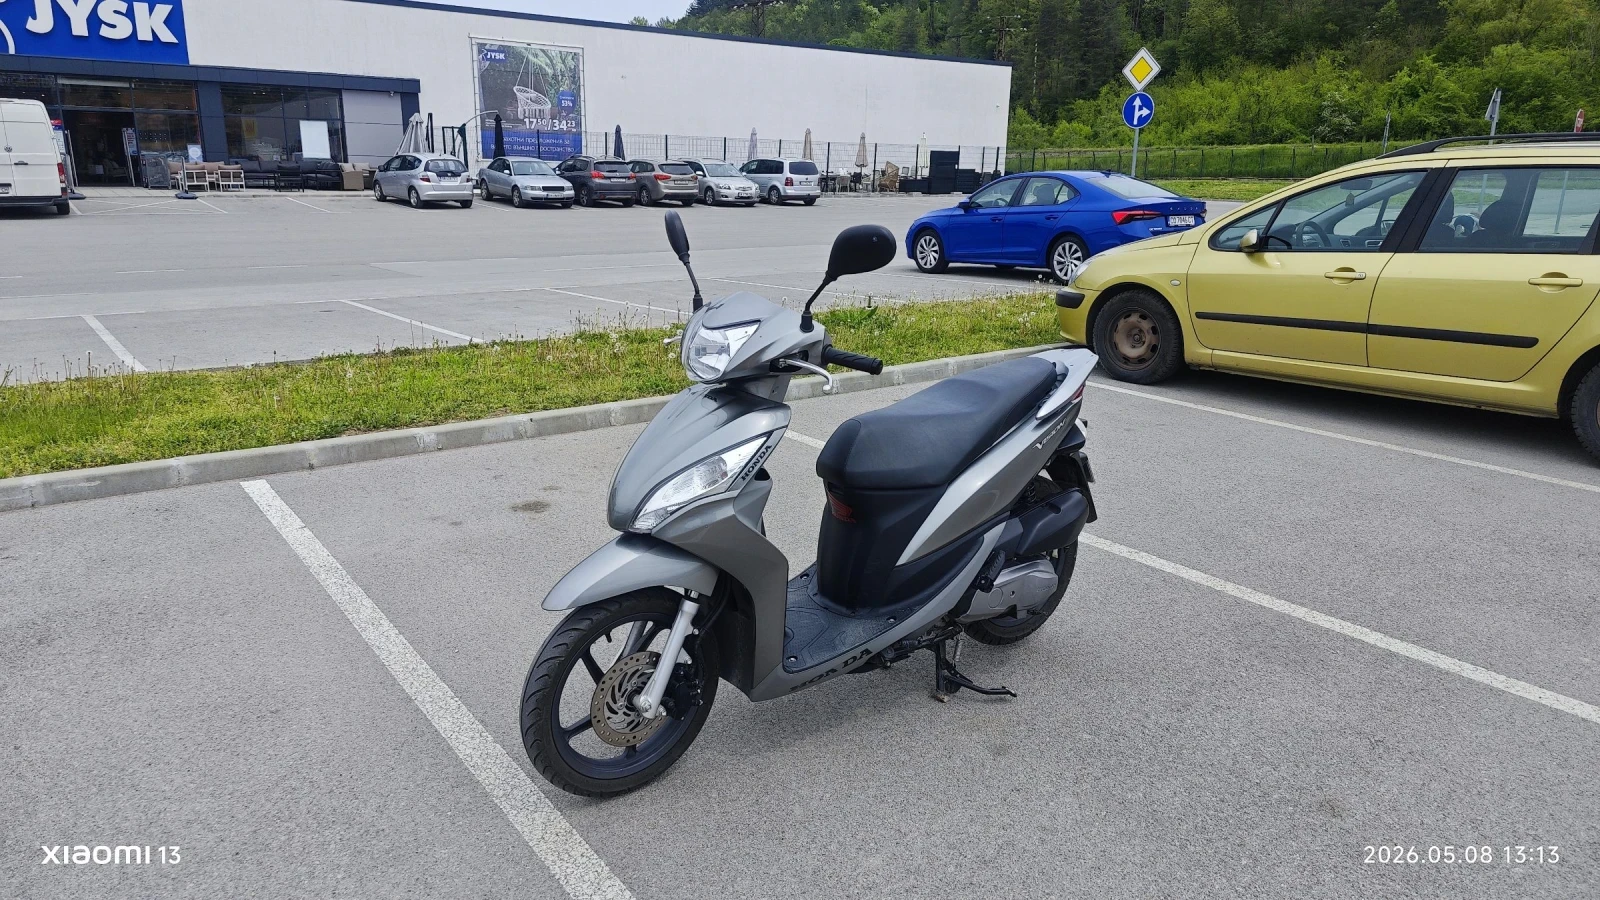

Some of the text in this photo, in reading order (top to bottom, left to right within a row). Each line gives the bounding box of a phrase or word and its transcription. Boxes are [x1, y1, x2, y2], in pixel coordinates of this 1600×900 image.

[25, 0, 179, 43] JYSK
[487, 51, 506, 60] JYSK
[741, 445, 772, 481] HONDA
